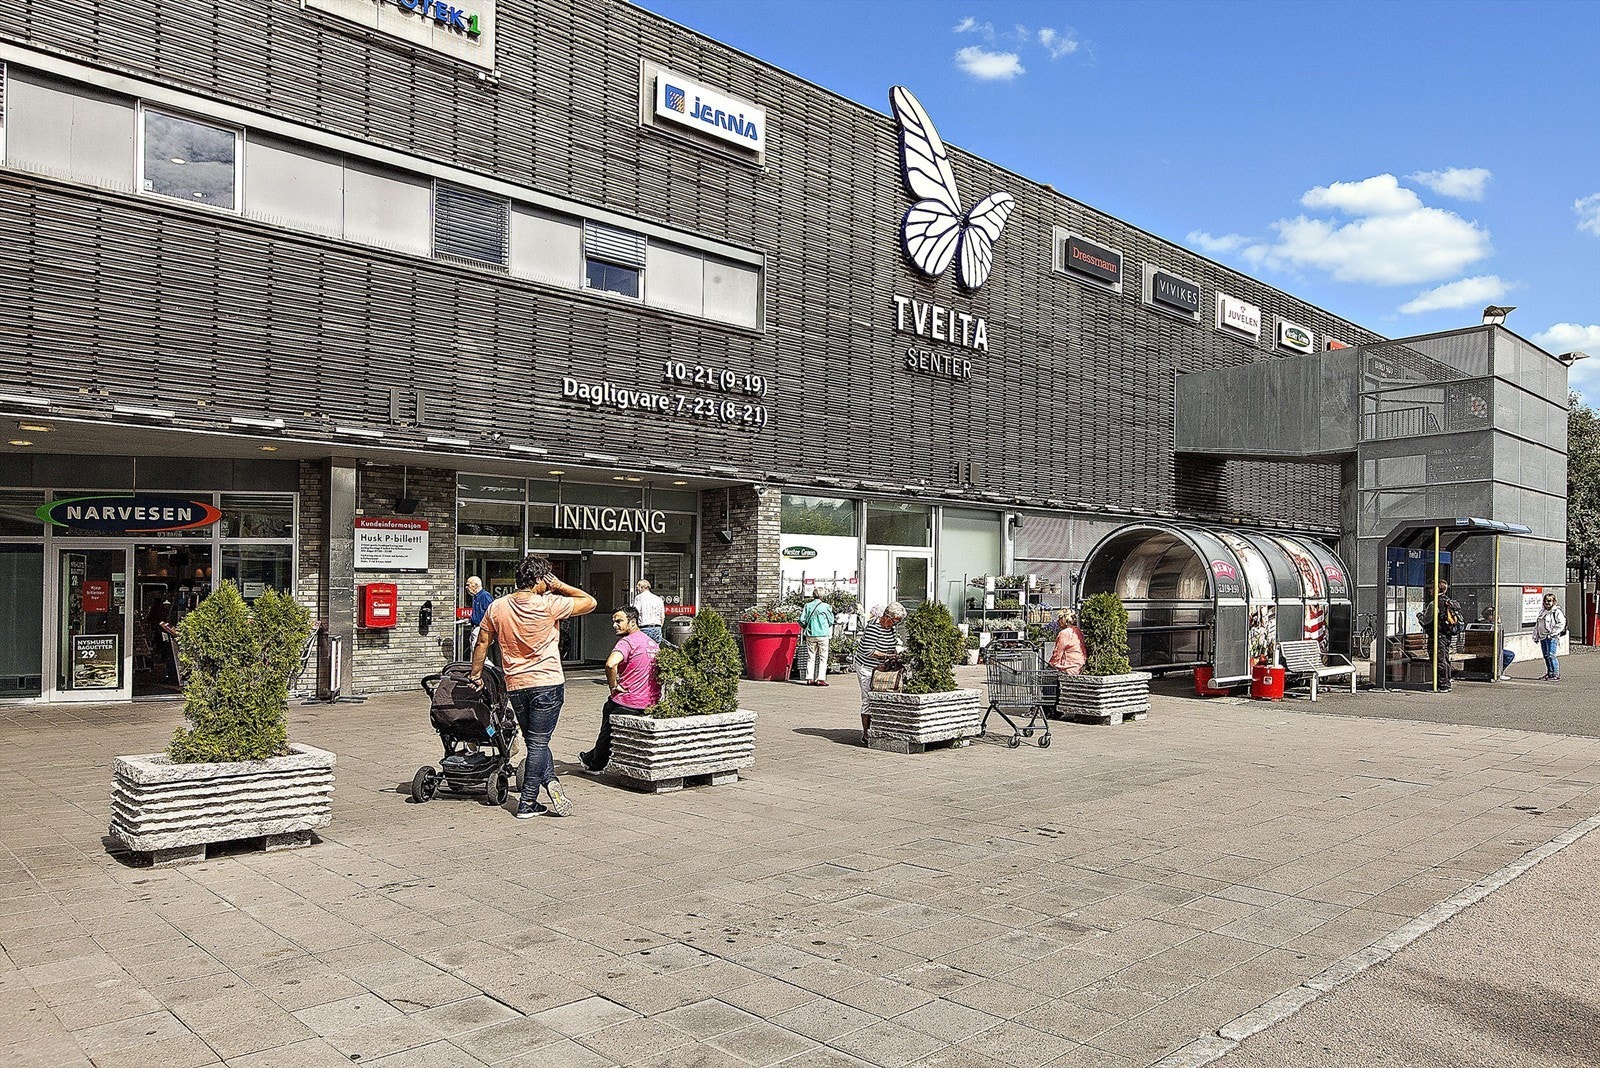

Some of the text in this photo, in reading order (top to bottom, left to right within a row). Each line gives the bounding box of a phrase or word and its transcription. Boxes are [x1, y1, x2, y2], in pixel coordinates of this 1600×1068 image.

[1072, 246, 1117, 274] Dressmann
[1160, 279, 1198, 305] VIVIKES
[893, 294, 989, 352] TVEITA
[1228, 309, 1259, 328] JUVELEN
[908, 347, 972, 379] SENTER
[664, 360, 768, 397] 10-21 (9-19)
[562, 377, 768, 427] Dagligvare 7-23 (8-21)
[66, 505, 193, 522] NARVESEN
[360, 520, 422, 530] Kundeinformasjon
[552, 504, 667, 534] INNGANG
[360, 533, 422, 544] Husk P-billett!
